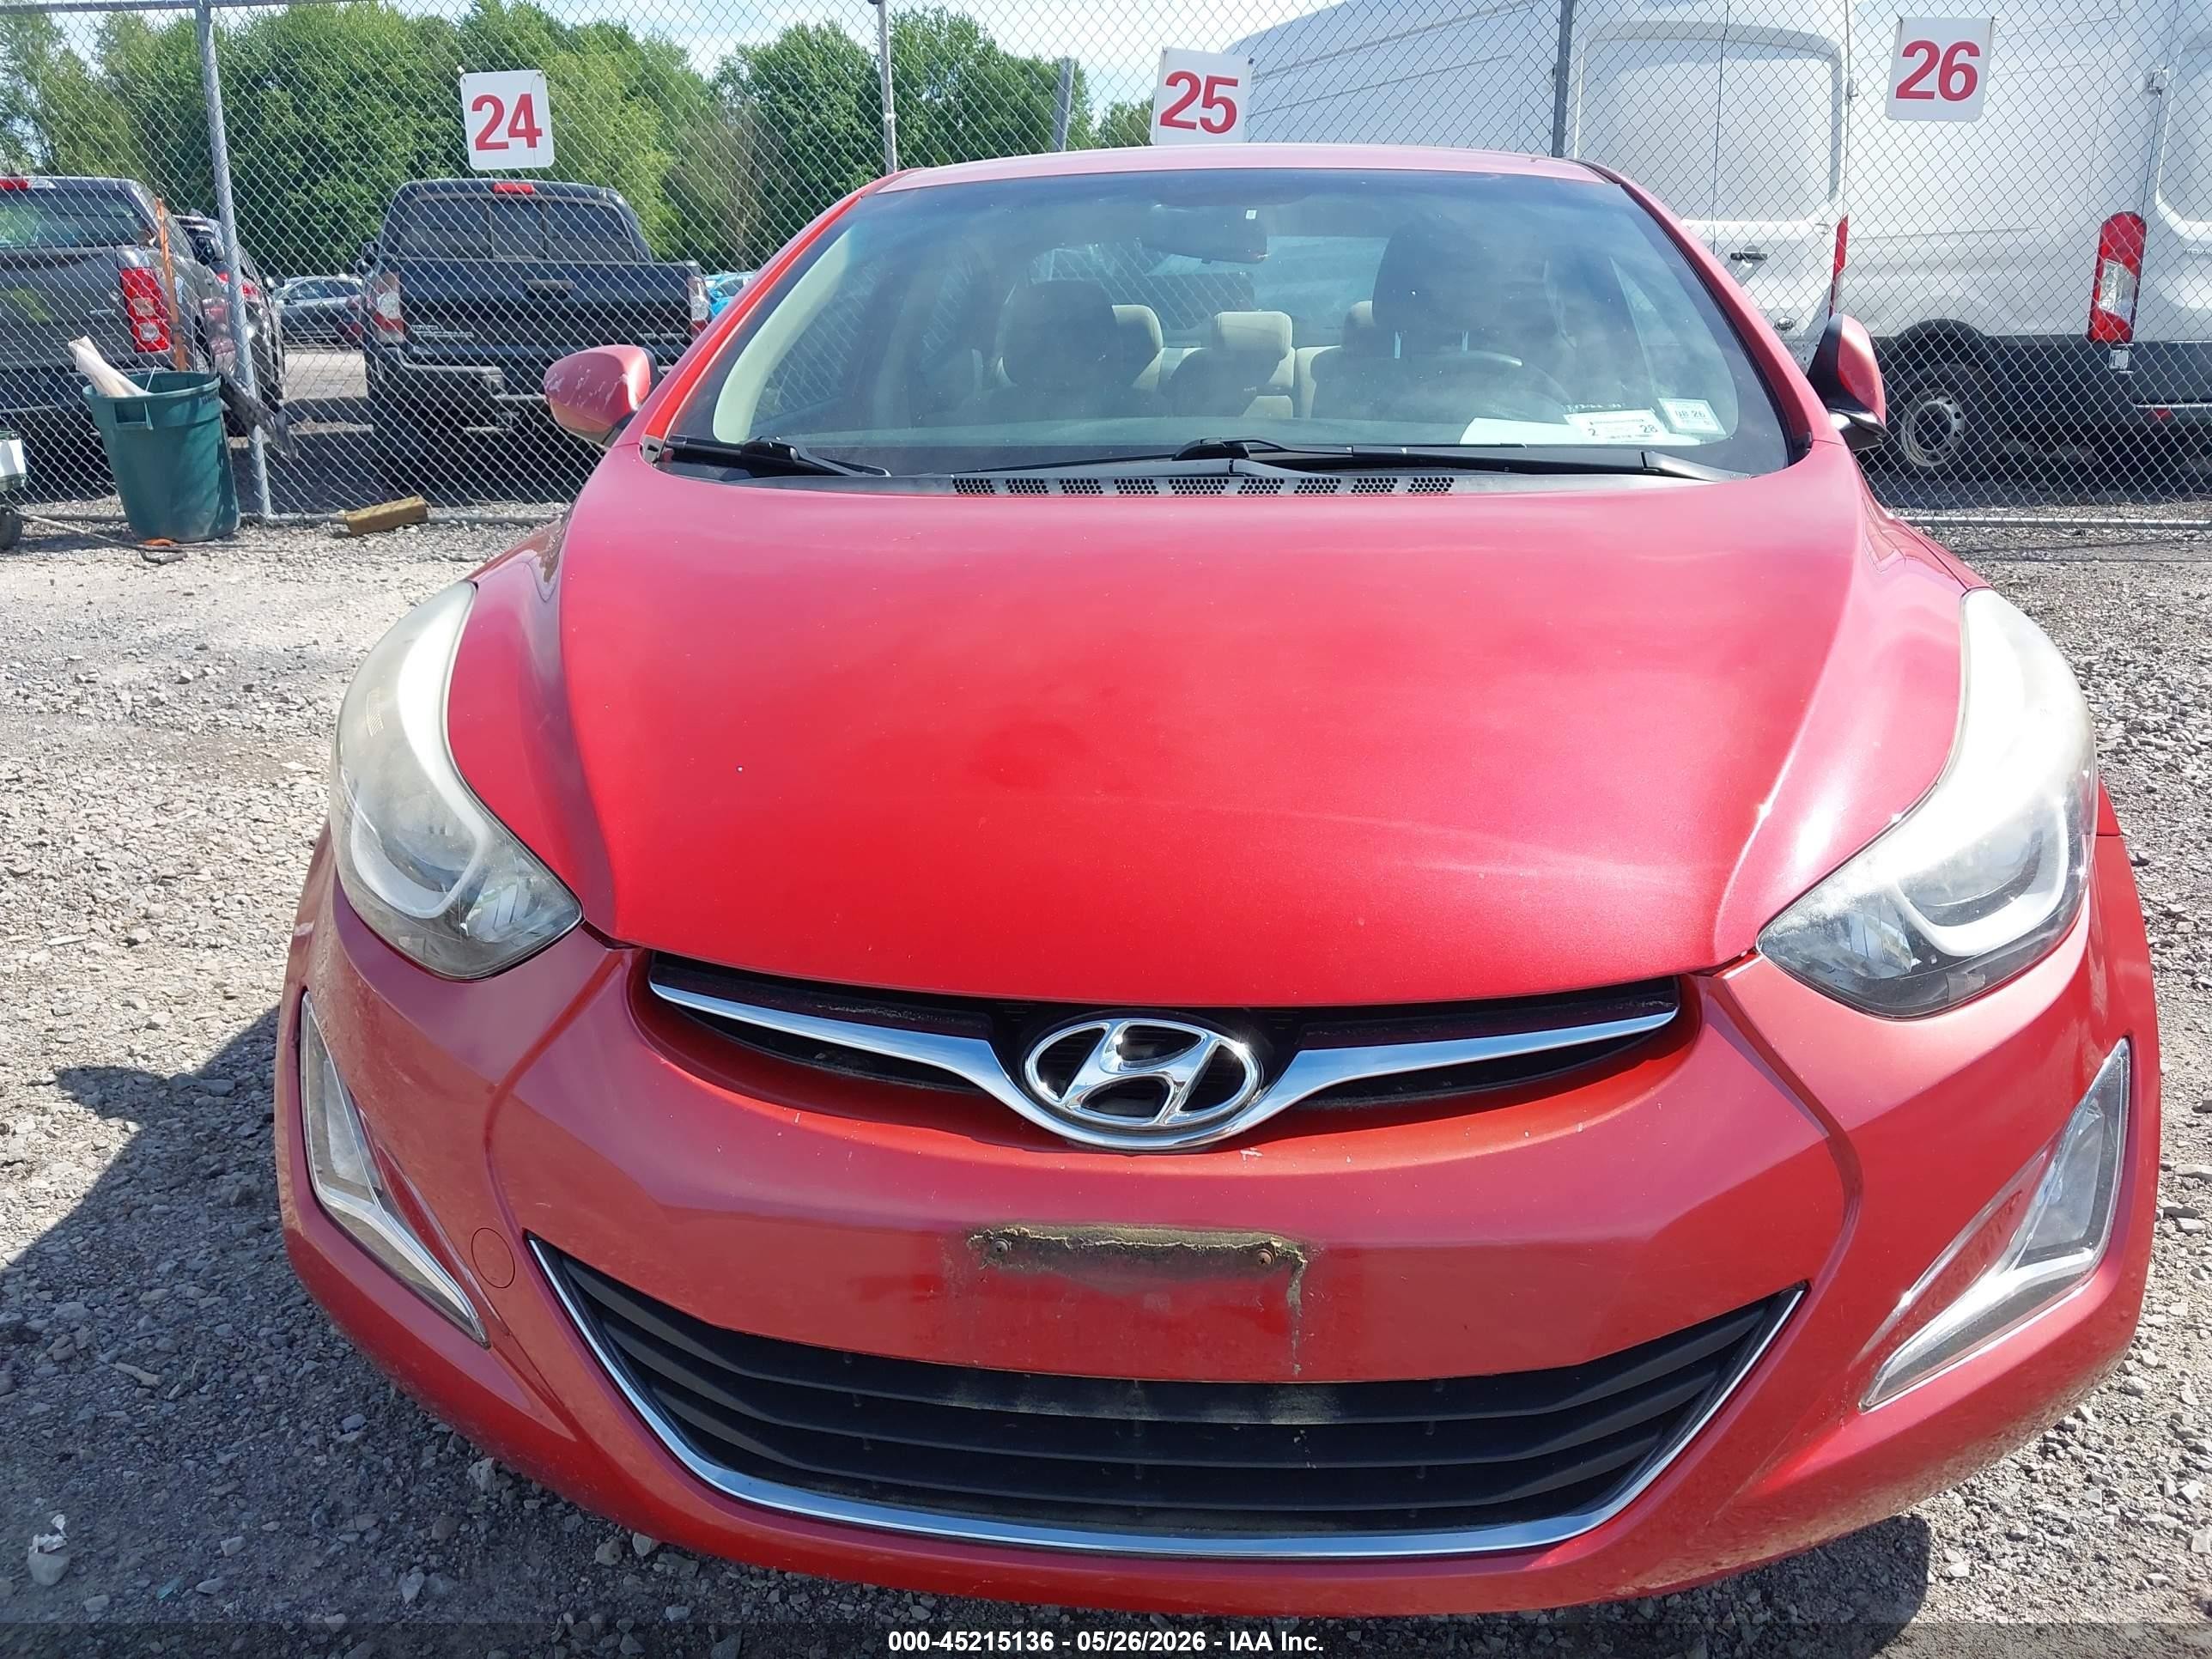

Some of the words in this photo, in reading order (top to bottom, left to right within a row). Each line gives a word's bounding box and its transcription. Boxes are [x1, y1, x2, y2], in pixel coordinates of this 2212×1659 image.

[1895, 40, 1981, 101] 26
[471, 93, 543, 151] 24
[1159, 70, 1239, 134] 25
